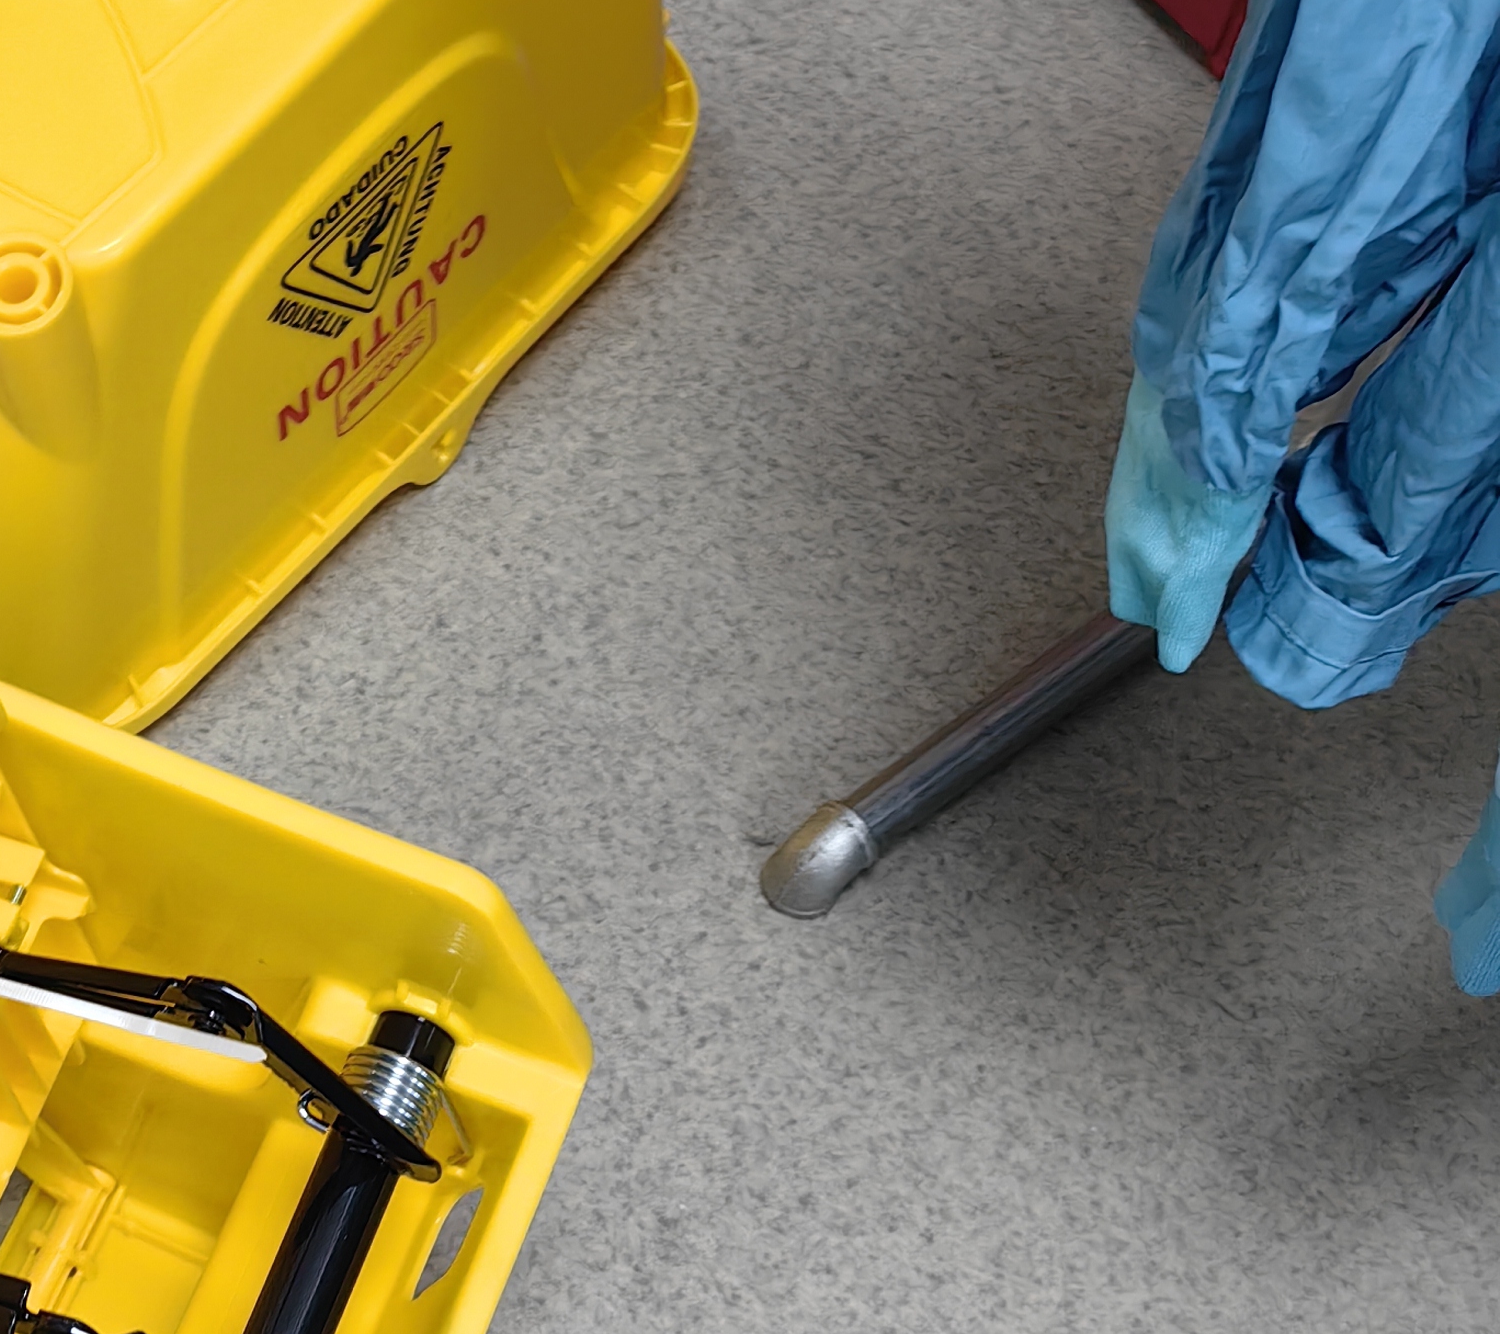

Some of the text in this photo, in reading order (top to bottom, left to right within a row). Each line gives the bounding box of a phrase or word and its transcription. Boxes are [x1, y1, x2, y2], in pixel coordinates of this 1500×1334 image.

[308, 135, 408, 241] CUIDADO
[390, 145, 452, 278] ACHTUNG
[266, 297, 354, 339] ATTENTION
[277, 214, 487, 442] CAUTION
